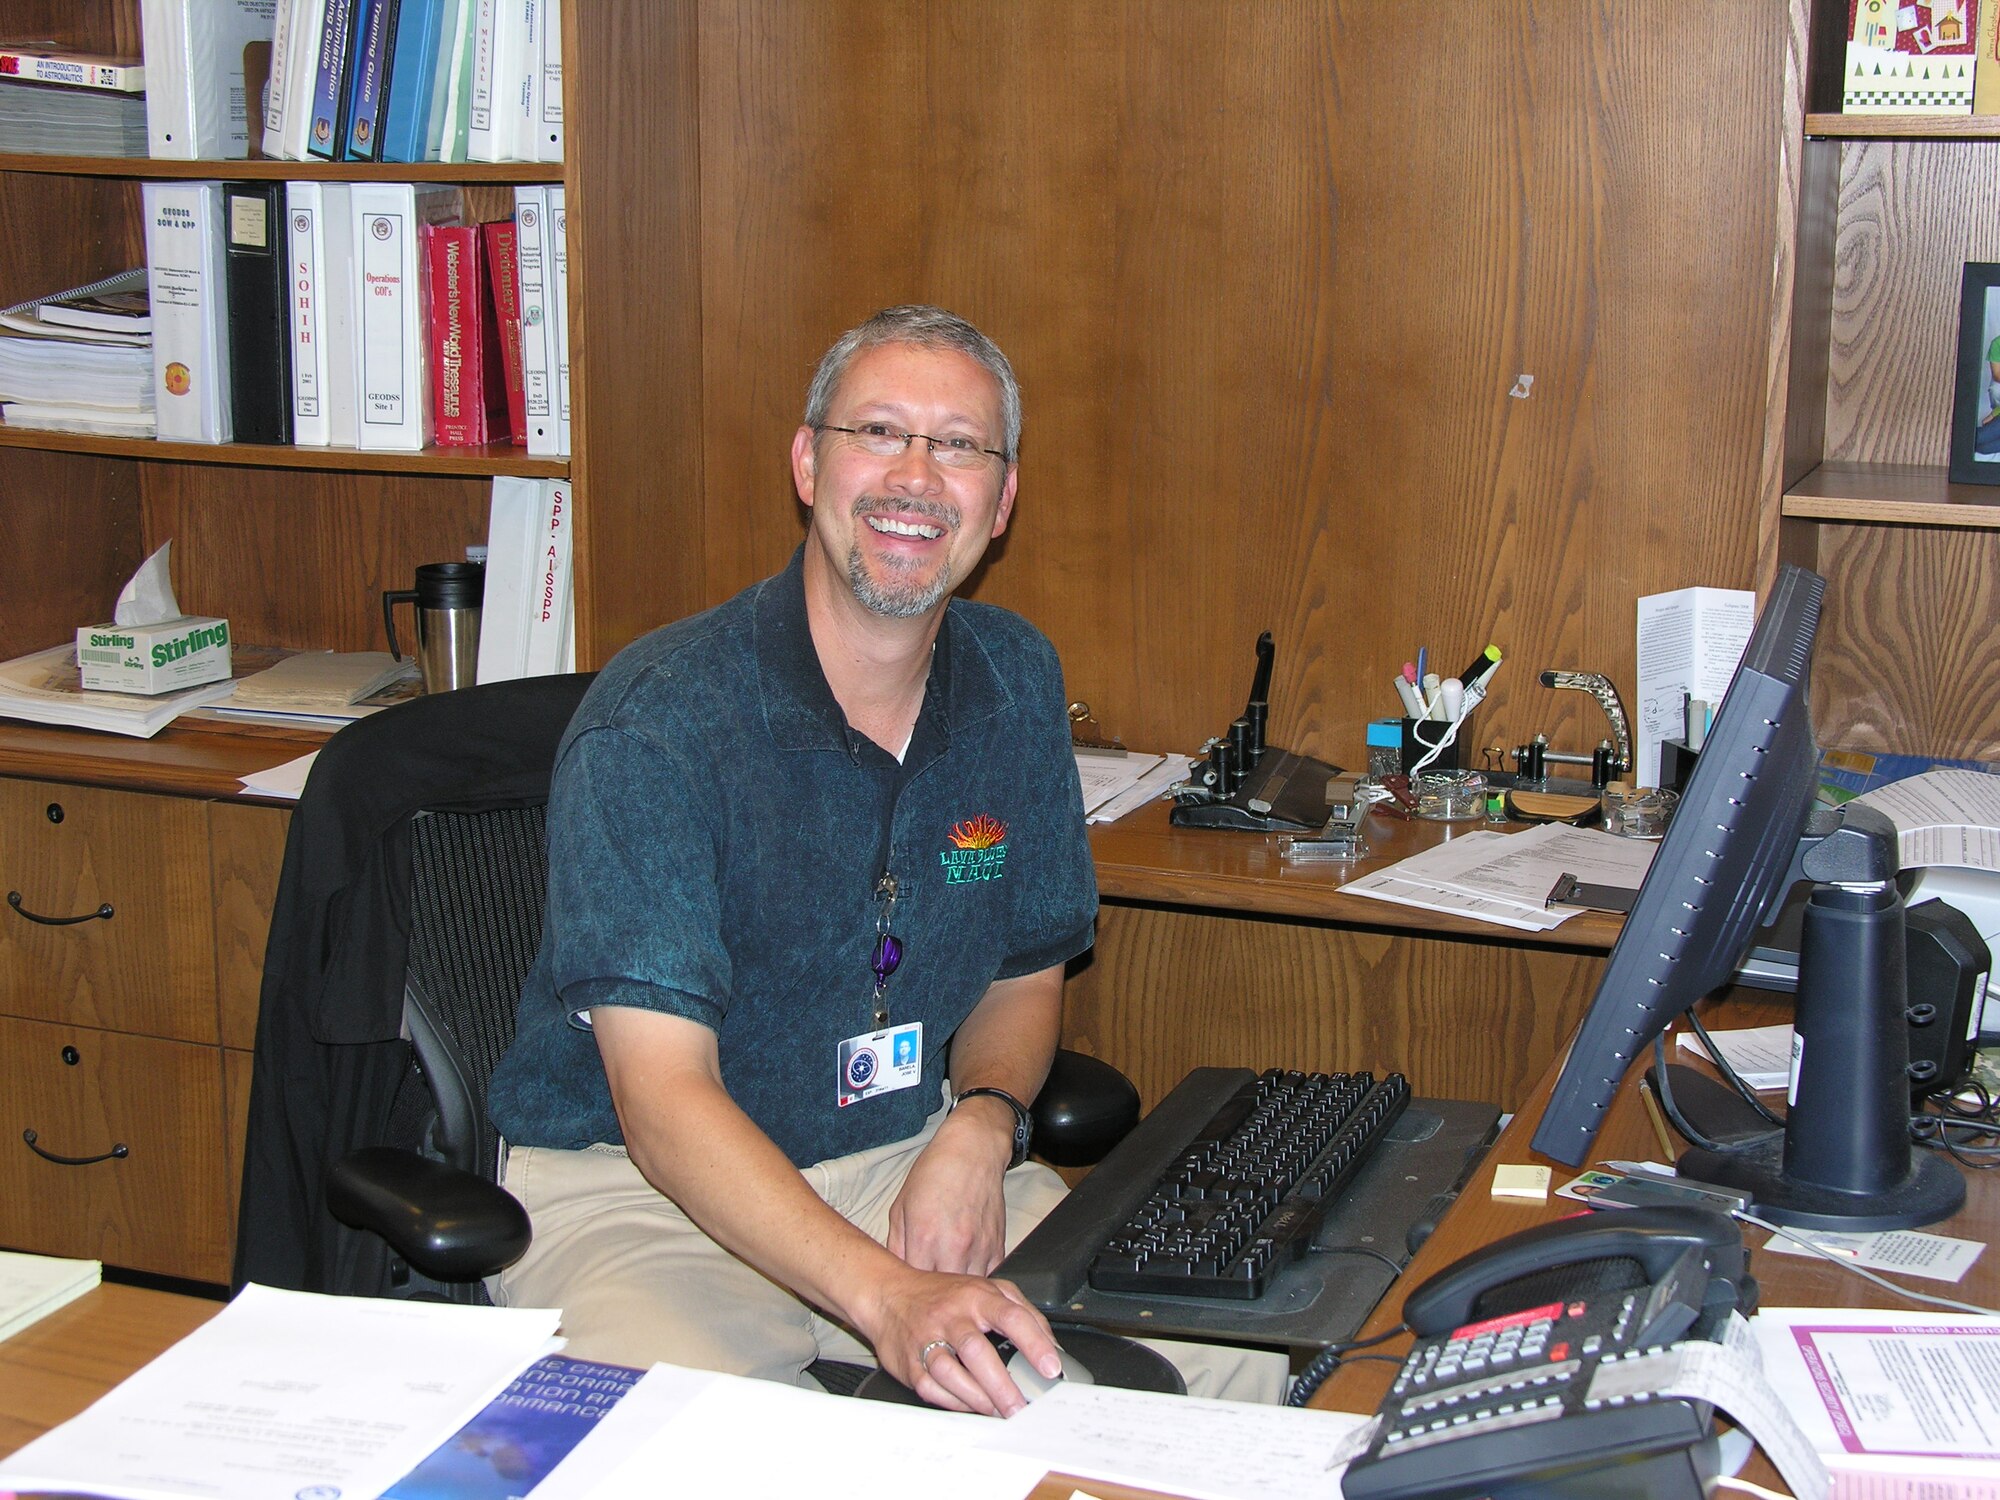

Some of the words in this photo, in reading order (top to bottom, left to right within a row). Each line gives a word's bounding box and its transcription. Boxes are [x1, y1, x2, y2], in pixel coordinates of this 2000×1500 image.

[368, 2, 382, 58] Training
[322, 28, 334, 70] Guide
[37, 70, 43, 78] TO
[44, 71, 83, 83] ASTRONAUTICS
[45, 62, 83, 73] INTRODUCTION
[364, 61, 375, 102] Guide
[162, 208, 190, 217] GEODSS
[366, 273, 400, 284] Operations
[447, 241, 460, 298] Webster's
[497, 232, 516, 317] Dictionary
[449, 325, 462, 358] World
[368, 393, 400, 401] GEODSS
[450, 358, 462, 418] Thesaurus
[375, 402, 388, 410] Site
[90, 634, 134, 649] Stirling
[152, 620, 228, 668] Stirling
[124, 661, 144, 670] Stirling
[946, 862, 1004, 884] MAUI
